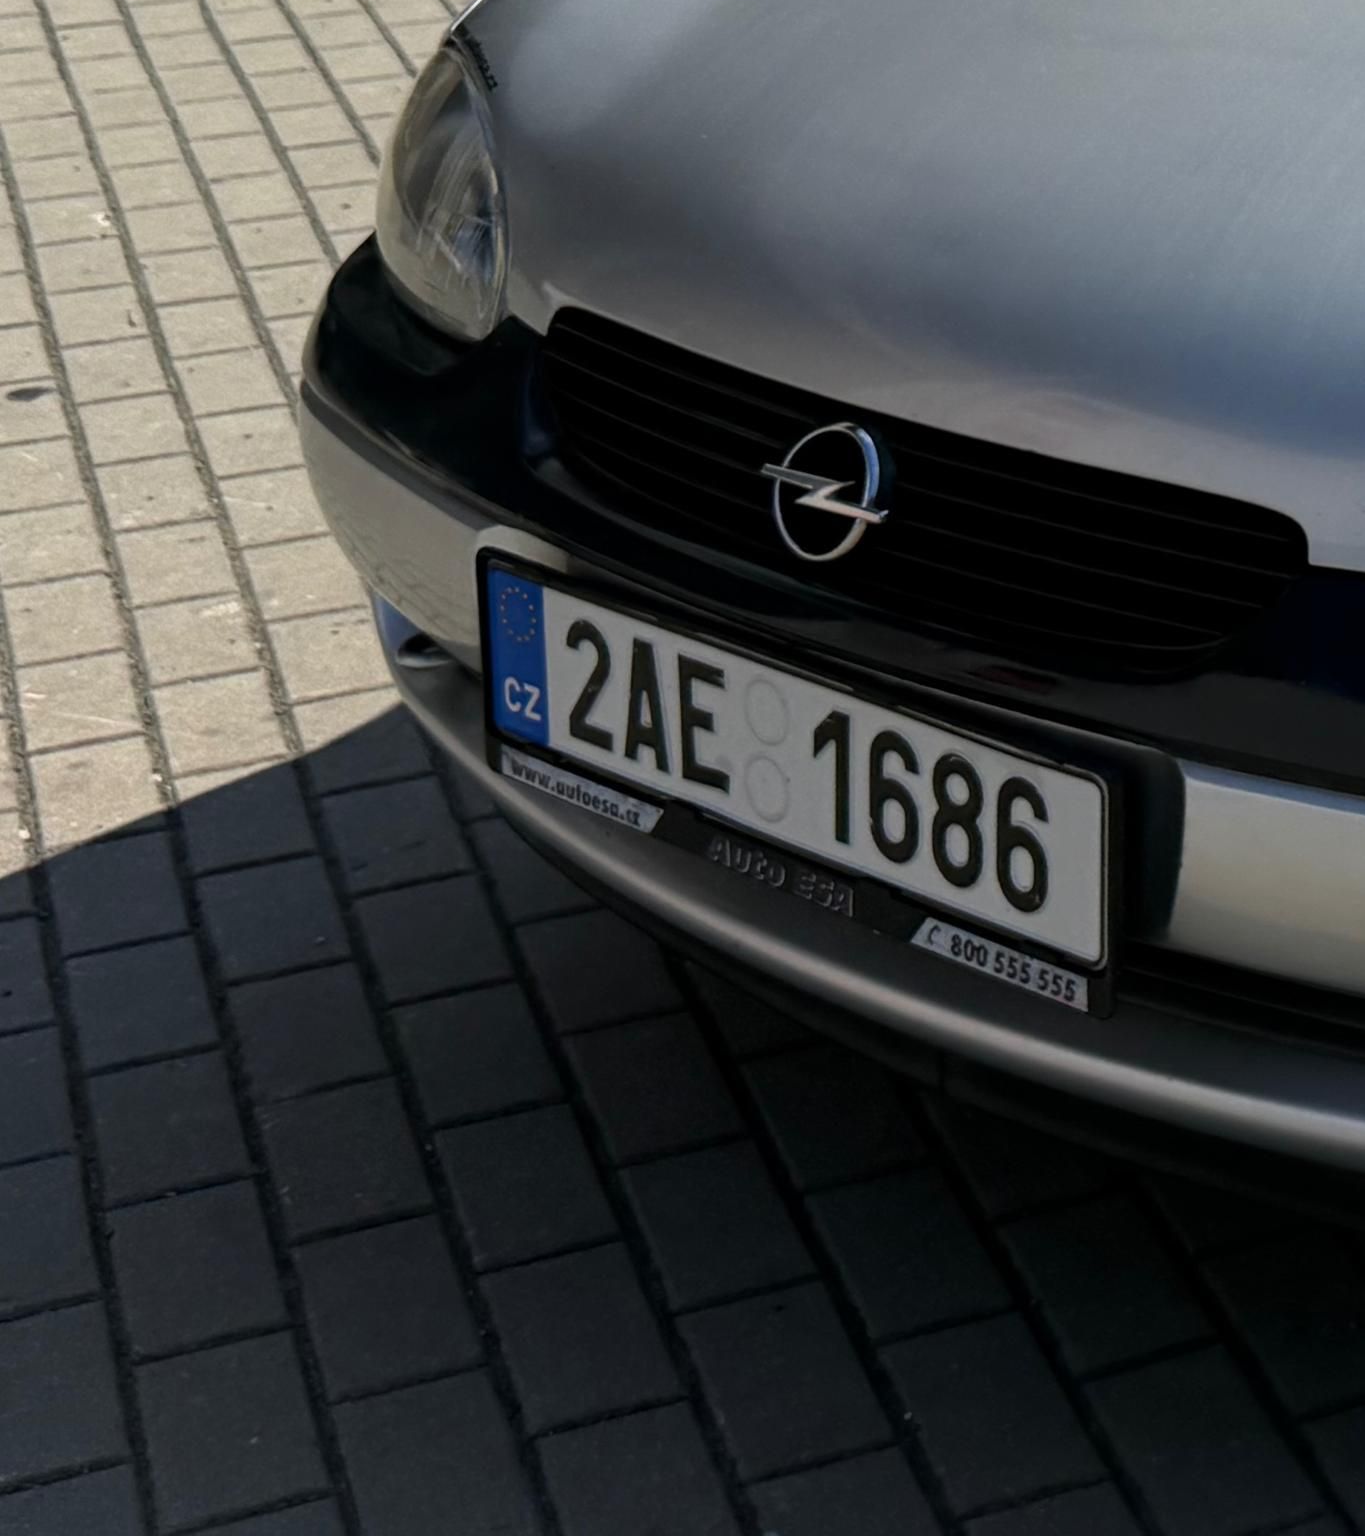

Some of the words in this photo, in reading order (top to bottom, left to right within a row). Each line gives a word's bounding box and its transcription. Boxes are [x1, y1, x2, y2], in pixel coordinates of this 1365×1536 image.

[504, 677, 541, 721] CZ
[511, 758, 641, 828] www.autoesa.cz
[566, 619, 731, 794] 2AE
[813, 710, 1049, 913] 1686
[950, 934, 989, 968] 800
[994, 951, 1032, 985] 555
[1037, 968, 1076, 1002] 555
